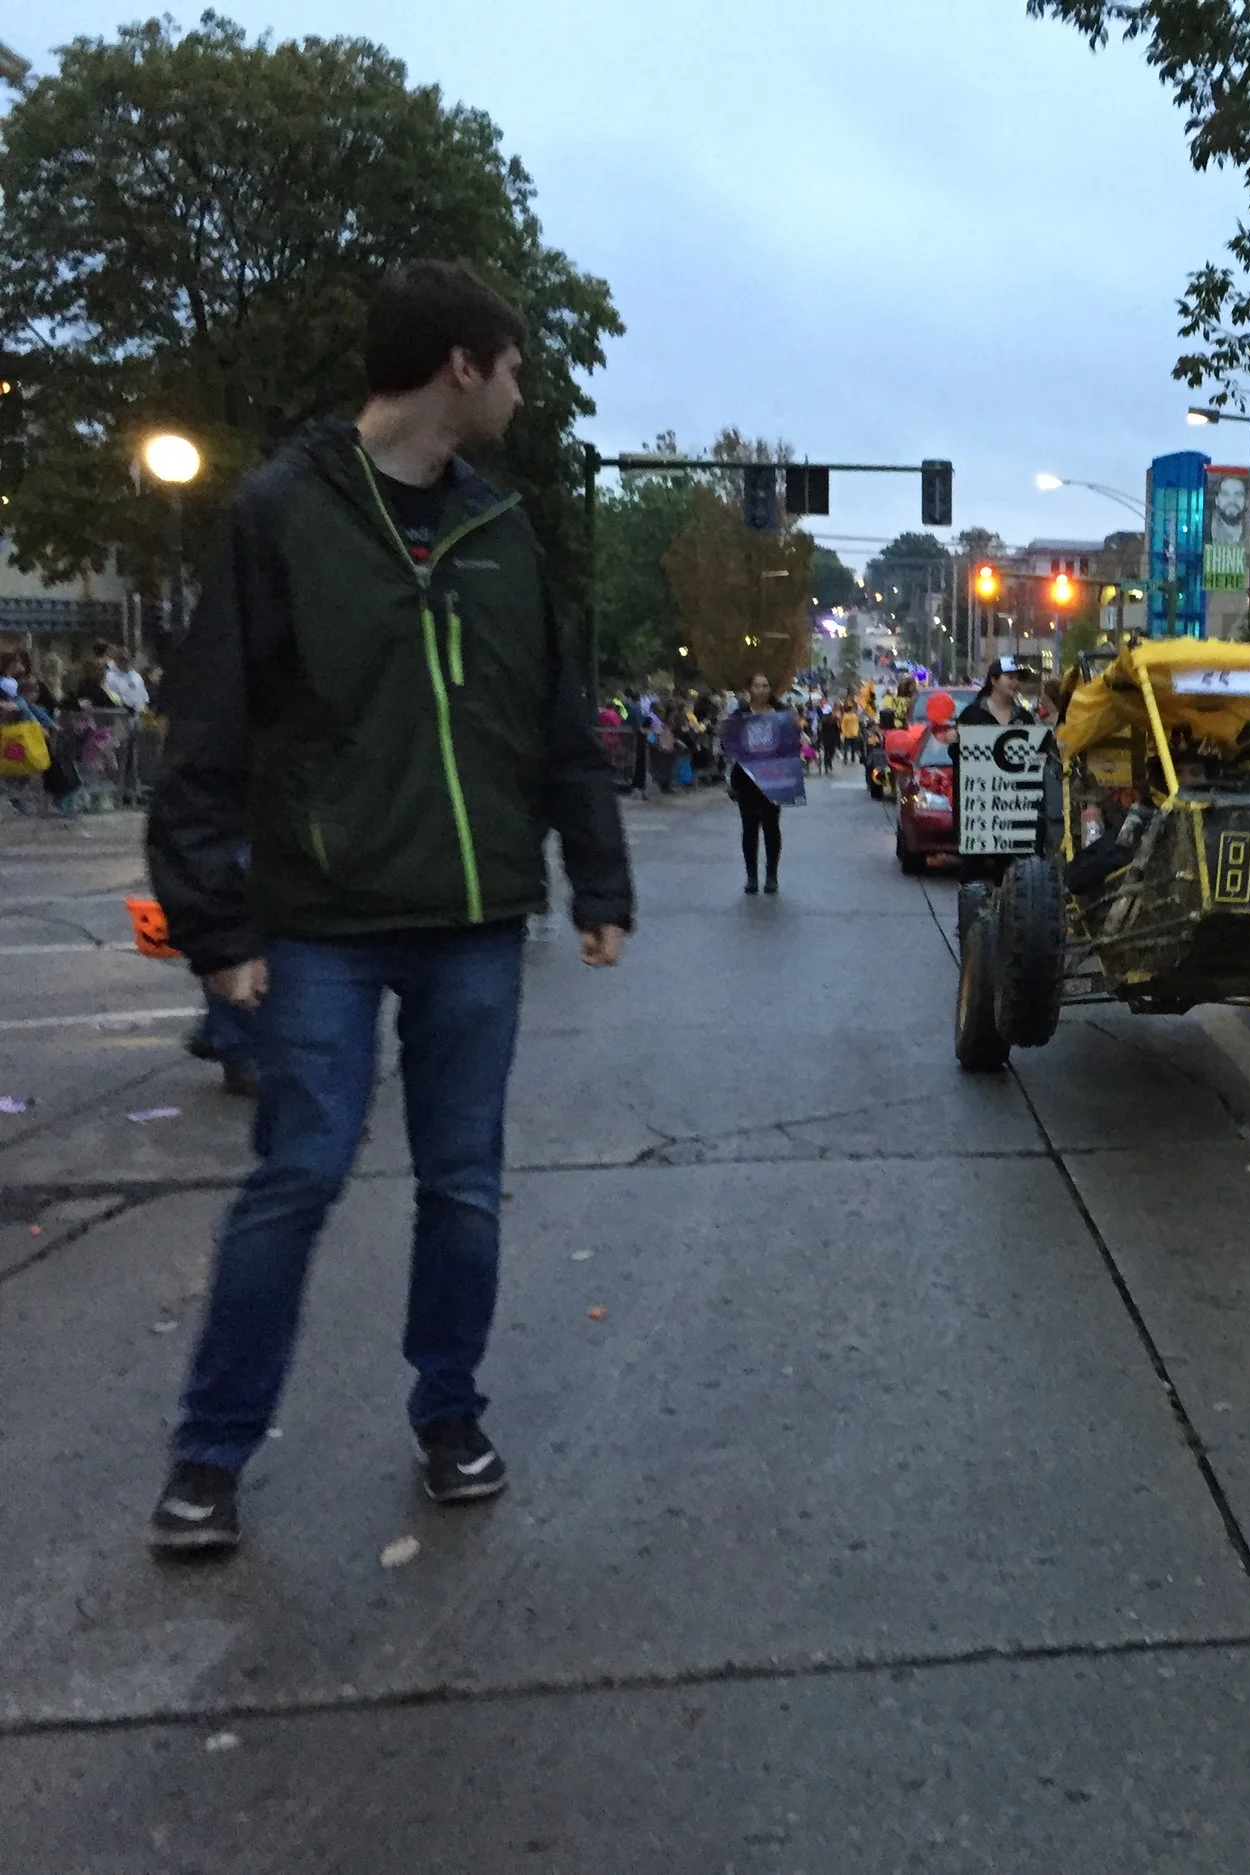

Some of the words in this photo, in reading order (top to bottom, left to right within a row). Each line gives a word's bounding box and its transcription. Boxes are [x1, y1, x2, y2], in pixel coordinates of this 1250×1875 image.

[1204, 544, 1245, 574] THINK
[1204, 573, 1245, 589] HERE
[964, 775, 986, 792] It's
[964, 795, 986, 812] It's
[964, 815, 986, 832] It's
[964, 835, 986, 851] It's
